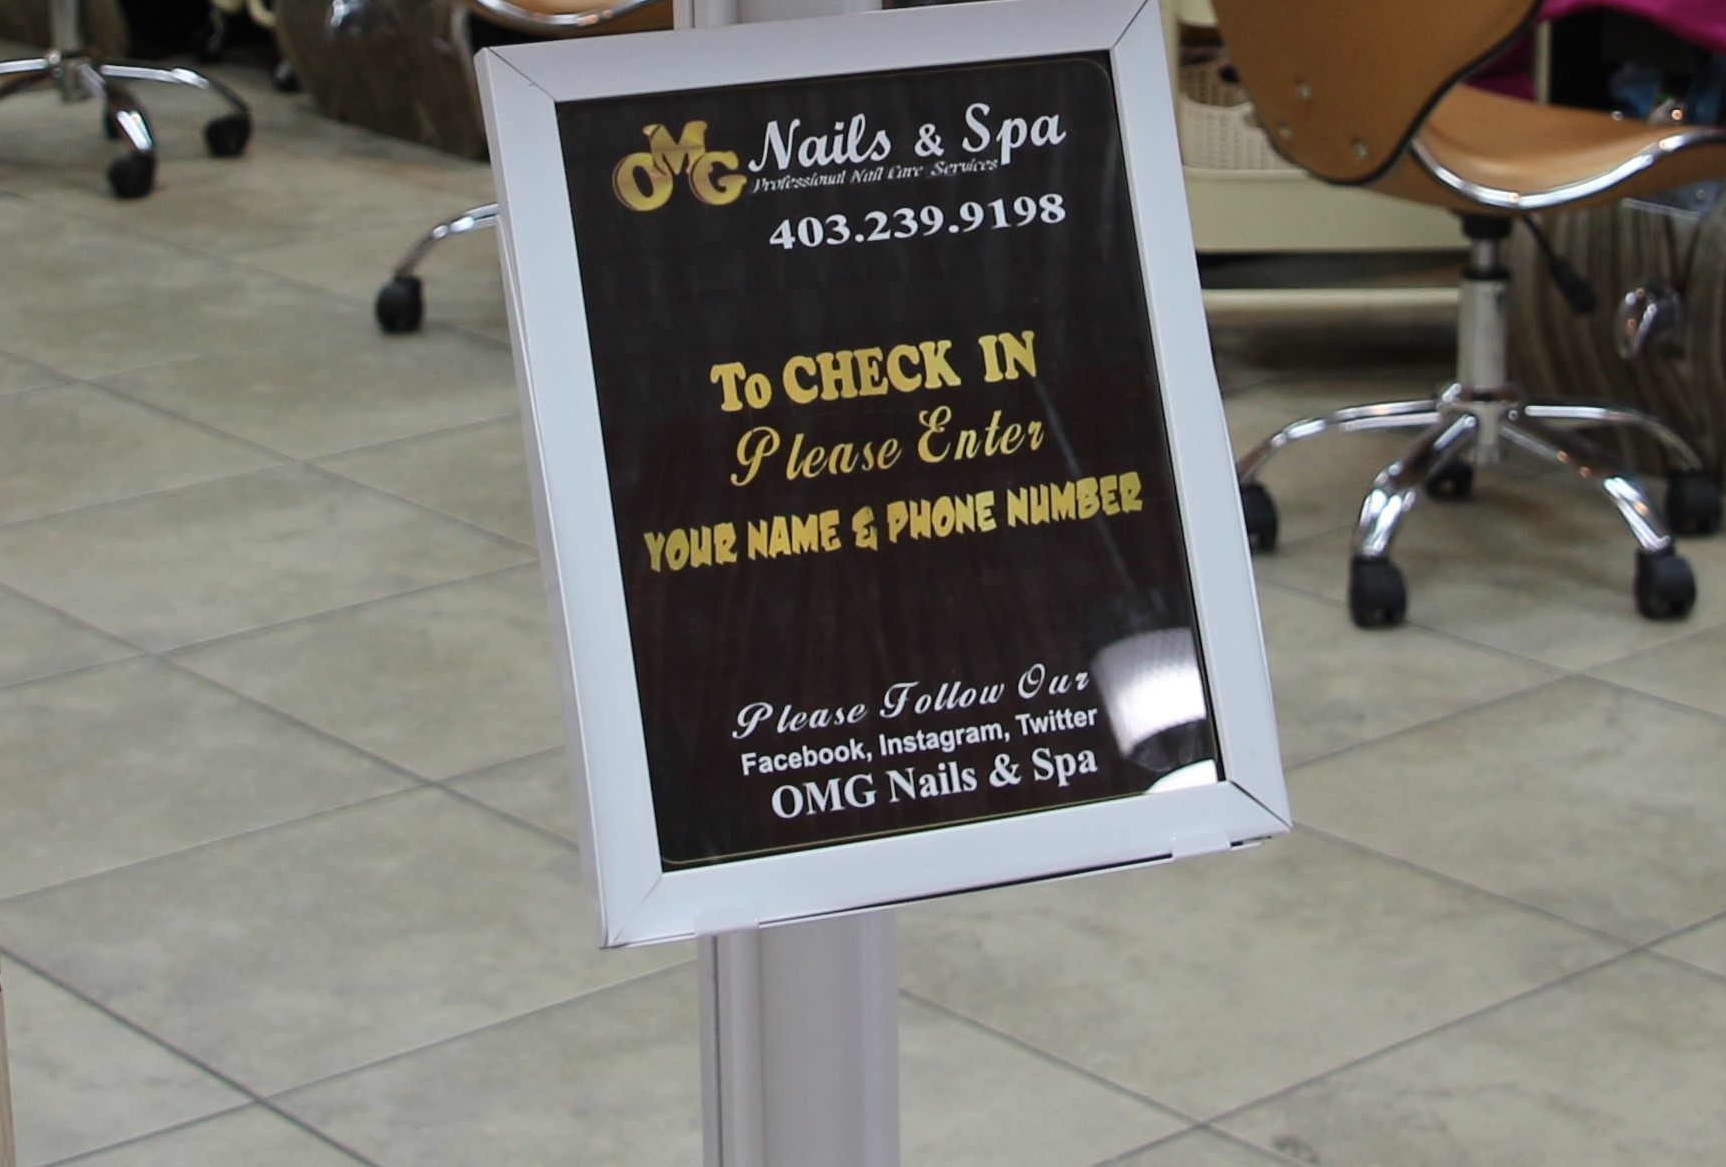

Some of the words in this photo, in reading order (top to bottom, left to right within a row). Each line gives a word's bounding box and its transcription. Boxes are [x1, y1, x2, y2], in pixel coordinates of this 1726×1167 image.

[612, 120, 748, 212] OMG
[748, 113, 892, 172] Nails
[914, 123, 944, 157] &
[962, 102, 1067, 165] Spa
[753, 170, 846, 193] Professional
[850, 167, 883, 184] Nail
[886, 164, 924, 180] Care
[929, 158, 999, 177] Services
[769, 193, 1067, 250] 403.239.9198
[710, 361, 772, 412] To
[782, 339, 962, 405] CHECK
[978, 330, 1037, 384] IN
[730, 426, 902, 487] Please
[917, 406, 1045, 464] Enter
[644, 522, 738, 573] YOUR
[747, 509, 842, 561] NAME
[852, 505, 879, 552] &
[886, 490, 998, 544] PHONE
[1007, 471, 1143, 528] NUMBER
[731, 701, 868, 740] Please
[879, 679, 1005, 718] Follow
[1017, 663, 1089, 699] Our
[740, 737, 873, 776] Facebook,
[879, 721, 1010, 756] Instagram,
[1014, 706, 1098, 736] Twitter
[771, 773, 877, 819] OMG
[885, 761, 978, 803] Nails
[988, 753, 1022, 788] &
[1031, 746, 1098, 788] Spa
